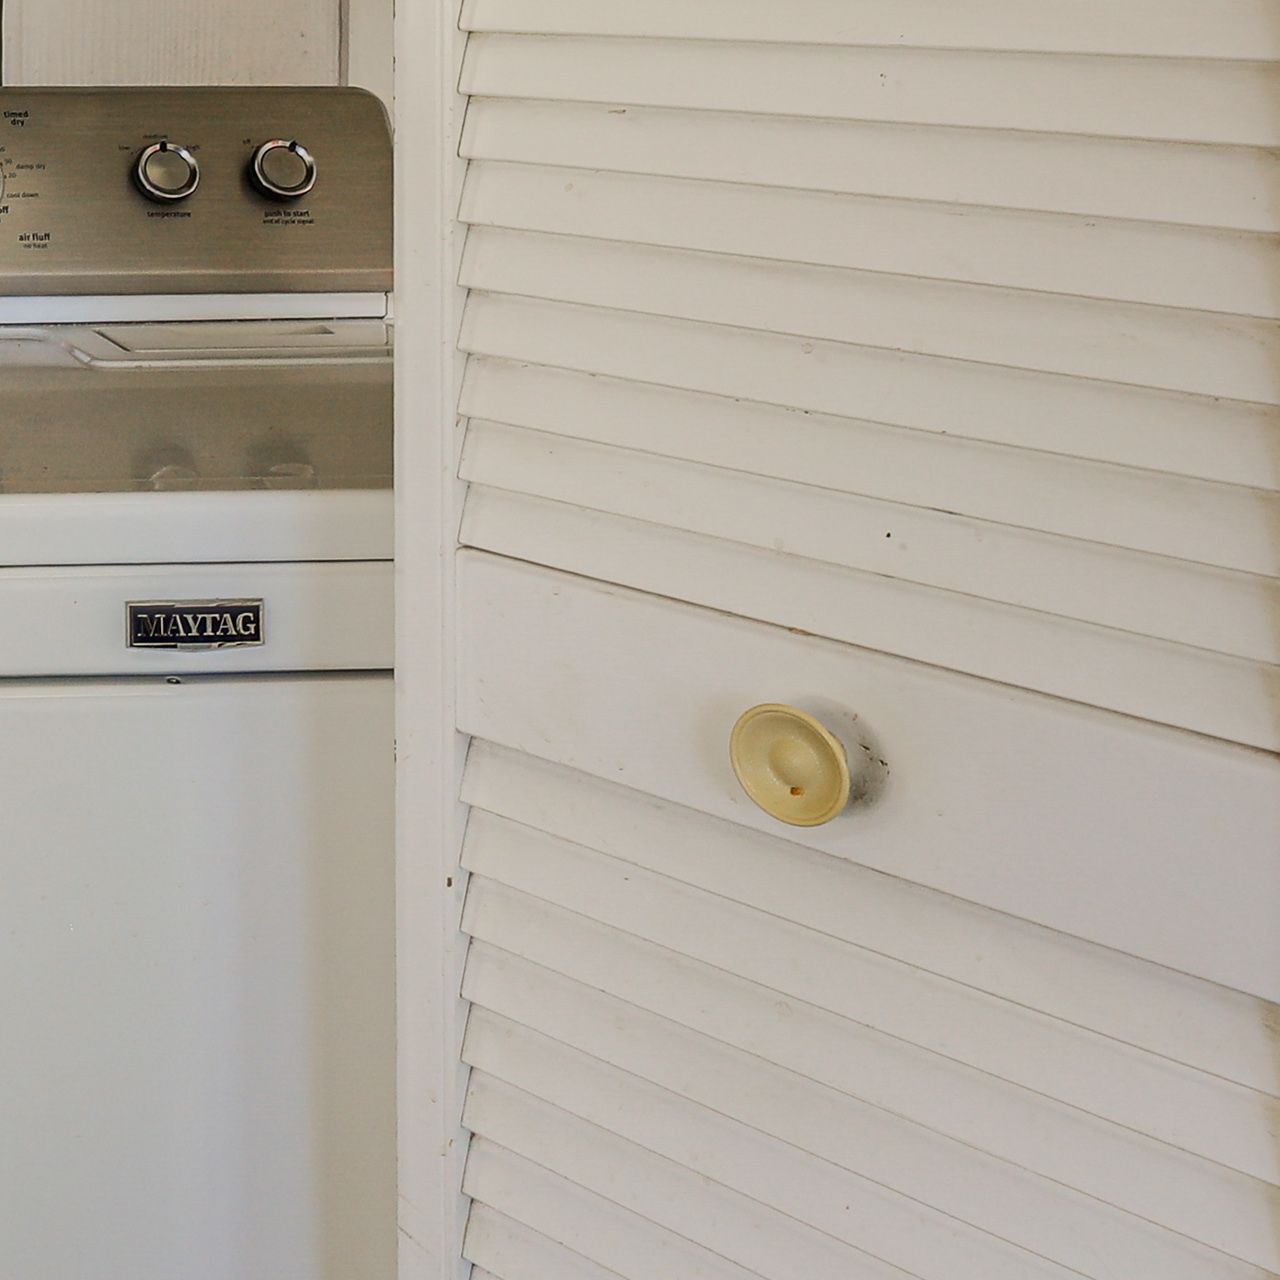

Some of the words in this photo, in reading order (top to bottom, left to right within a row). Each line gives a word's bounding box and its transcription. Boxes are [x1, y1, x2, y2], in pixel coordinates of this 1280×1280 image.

[10, 119, 24, 127] dry
[147, 211, 191, 219] temperature
[264, 210, 282, 218] push
[19, 233, 30, 241] air
[32, 232, 50, 241] fluff
[137, 612, 256, 637] MAYTAG
